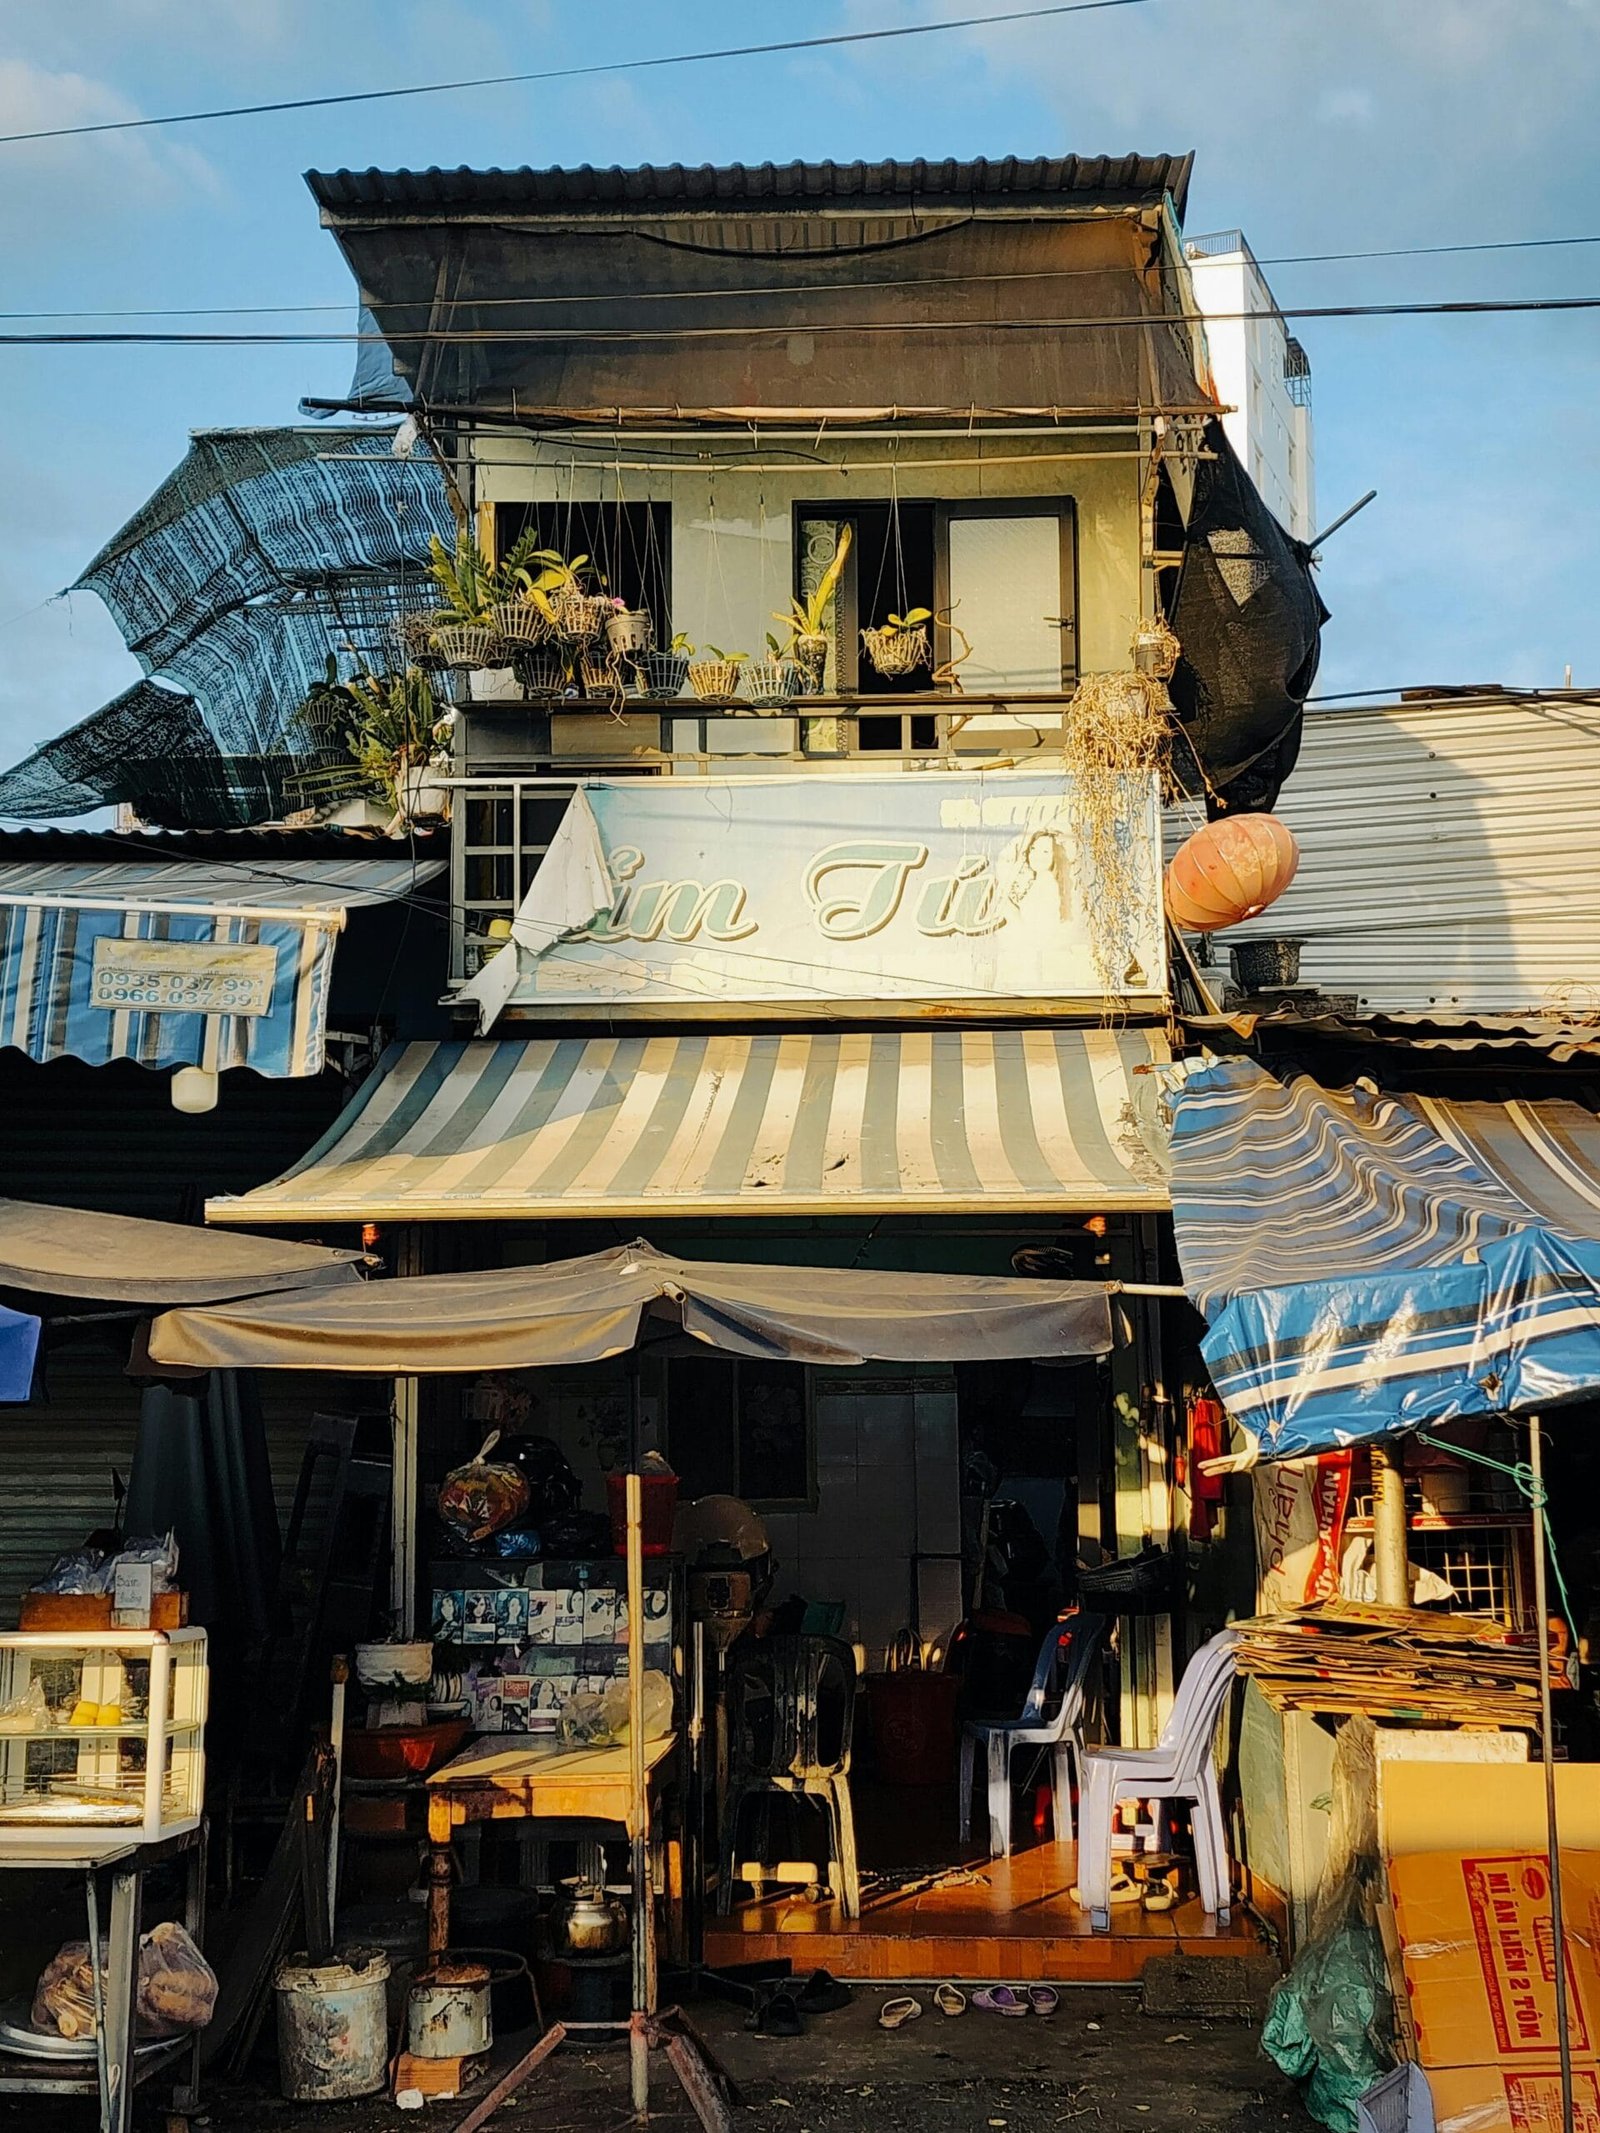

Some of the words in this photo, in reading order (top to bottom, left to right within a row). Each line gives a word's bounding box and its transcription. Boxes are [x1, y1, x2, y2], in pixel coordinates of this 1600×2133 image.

[1493, 1899, 1520, 1924] ĂN
[1509, 1977, 1531, 1990] 2
[1512, 1995, 1543, 2039] TÔM
